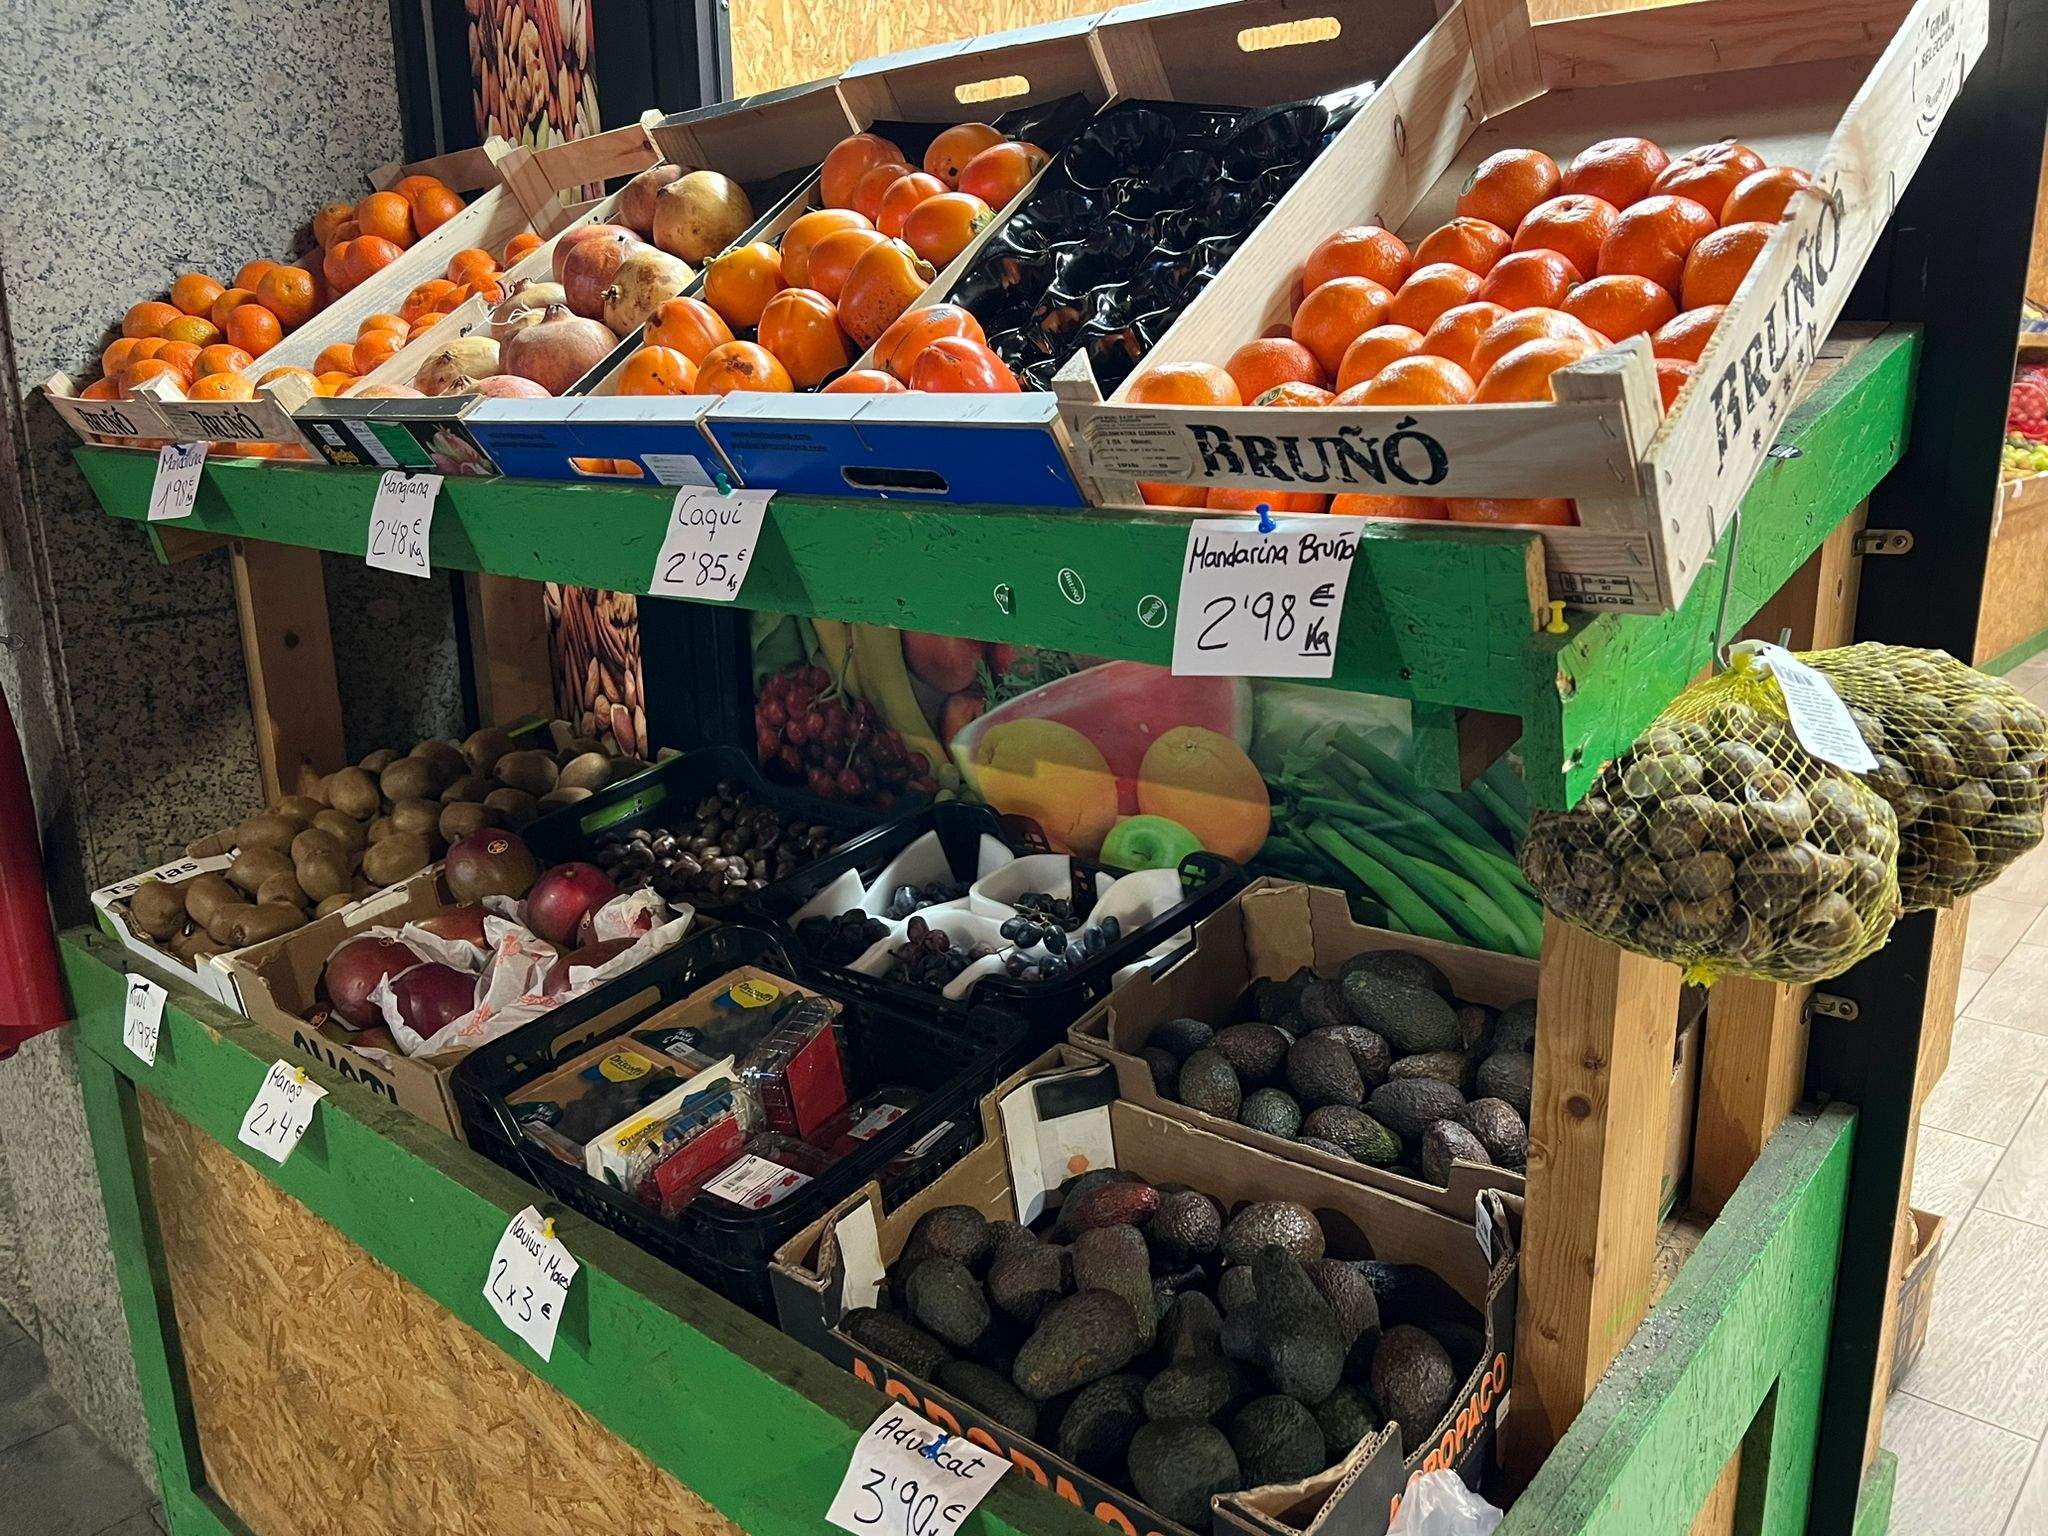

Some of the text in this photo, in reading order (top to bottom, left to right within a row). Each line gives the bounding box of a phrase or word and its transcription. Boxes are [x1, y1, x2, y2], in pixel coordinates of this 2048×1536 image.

[1185, 414, 1450, 486] BRUÑÓ
[372, 518, 423, 555] 2'48 €
[678, 494, 743, 542] Caqui
[409, 540, 426, 567] Kg
[663, 548, 748, 587] 2'85 €
[1189, 535, 1289, 574] Mandarina
[1197, 582, 1336, 651] 2'98 €
[1298, 615, 1333, 657] Kg
[267, 1065, 303, 1104] Mango
[295, 1124, 304, 1140] €
[942, 1504, 966, 1522] €
